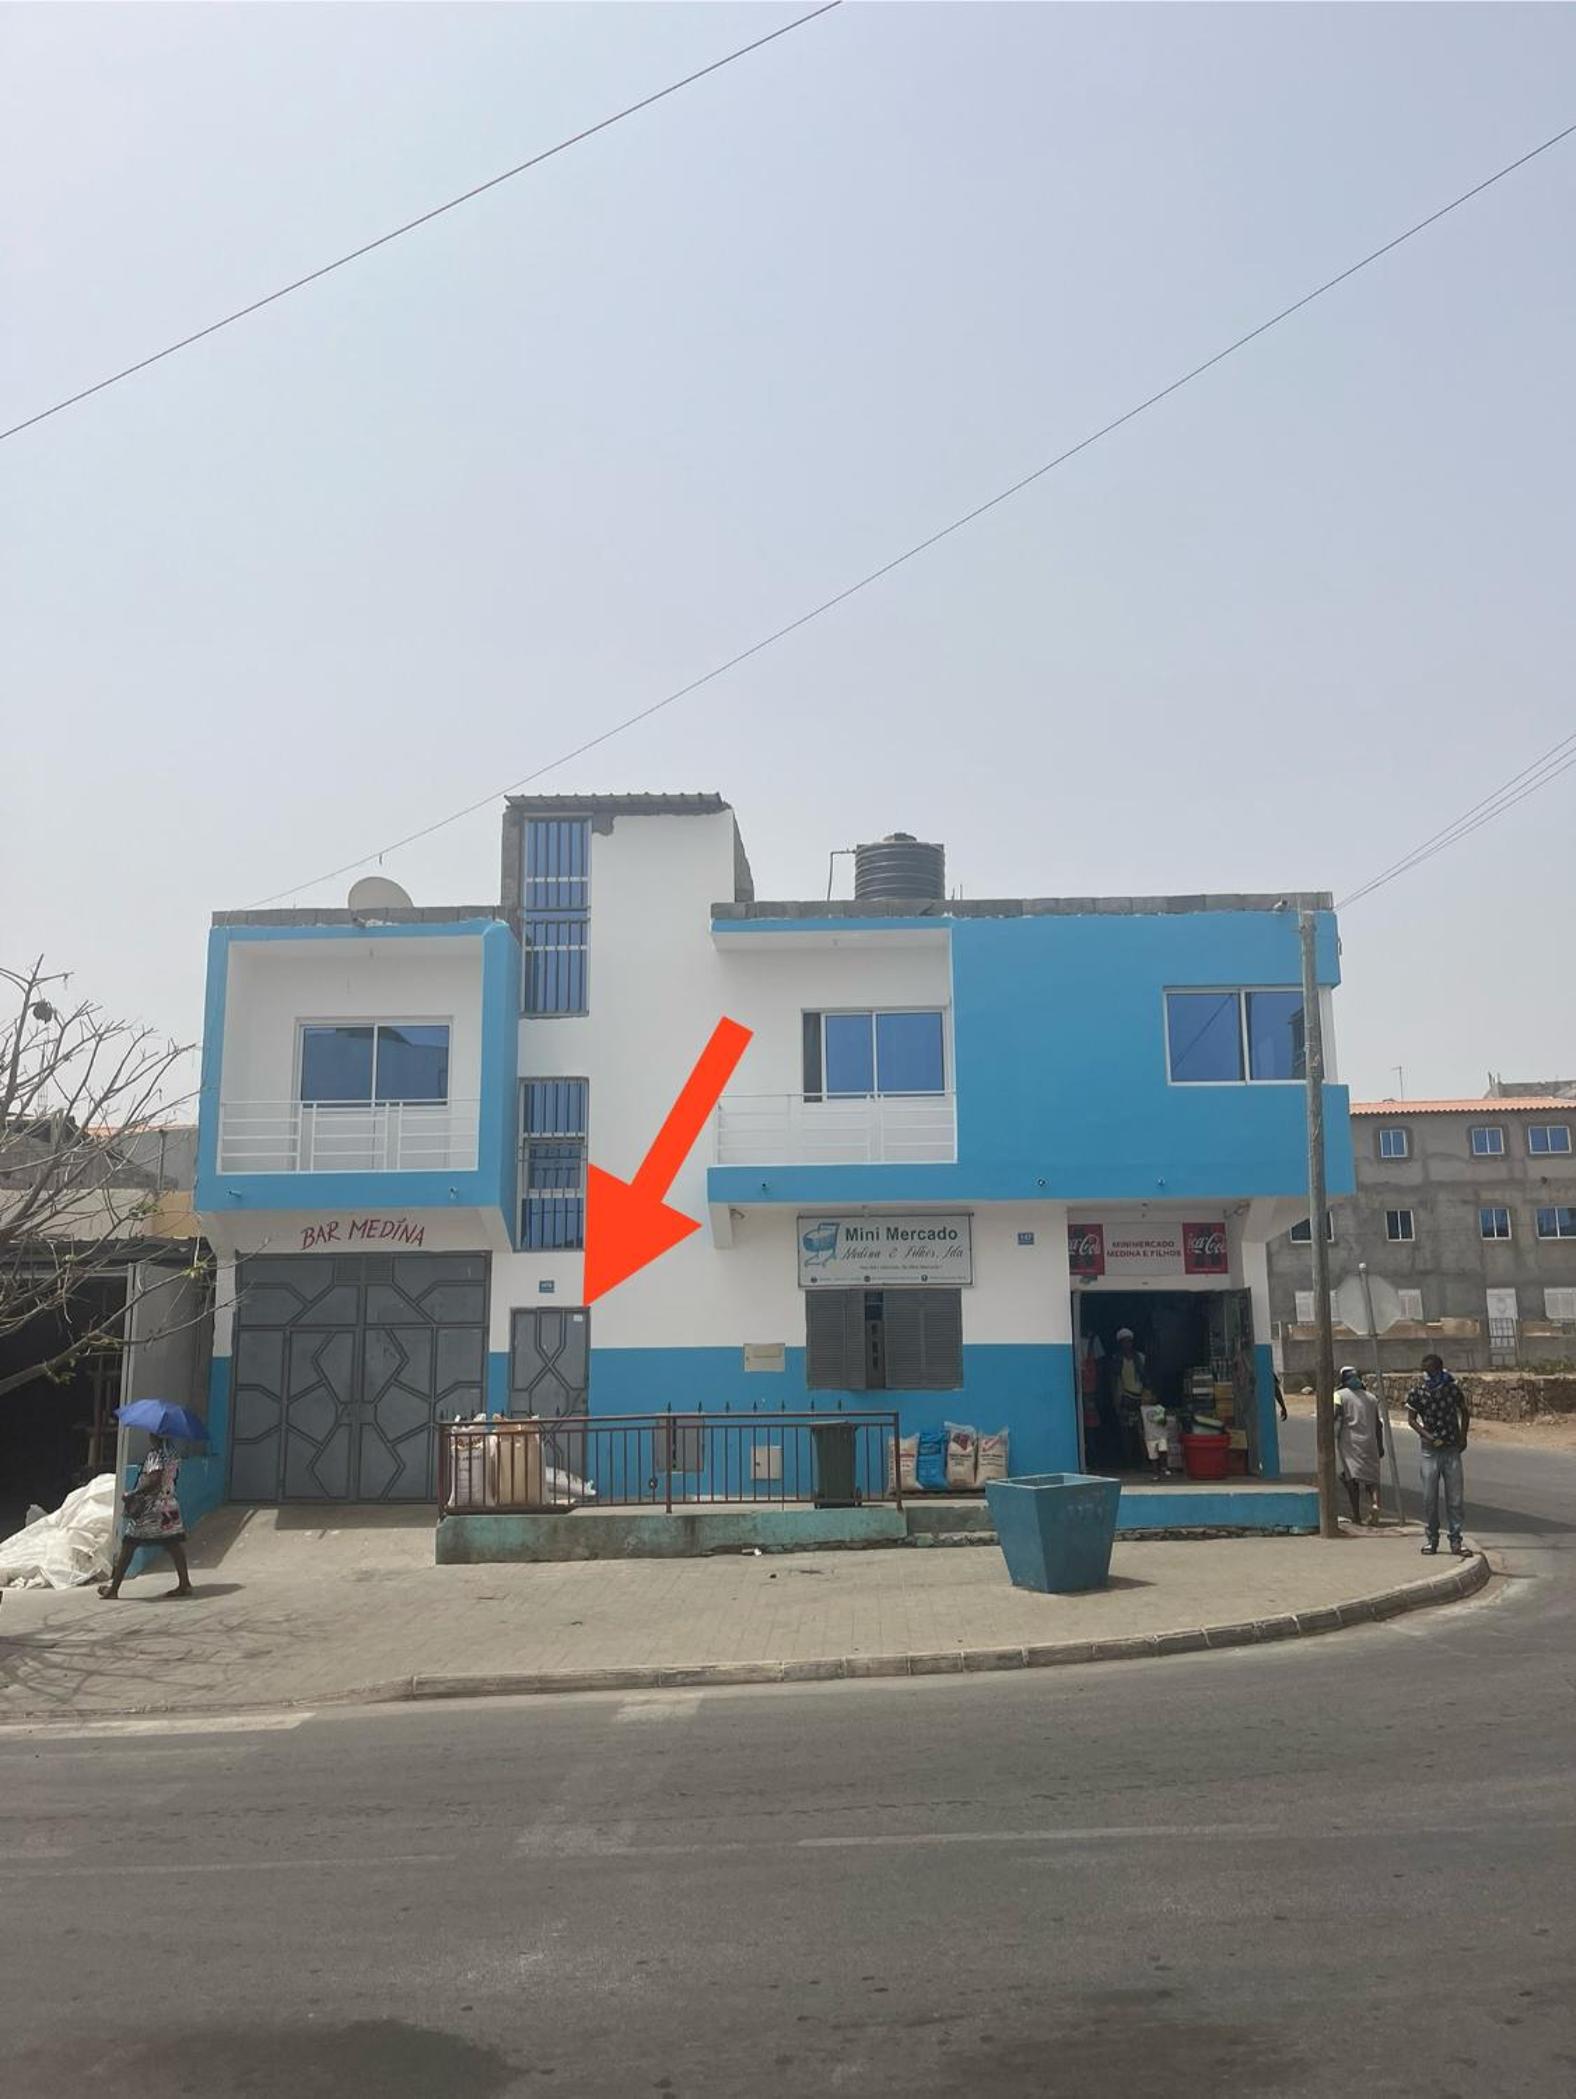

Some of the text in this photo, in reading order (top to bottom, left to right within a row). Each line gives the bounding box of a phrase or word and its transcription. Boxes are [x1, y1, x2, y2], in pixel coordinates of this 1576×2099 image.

[300, 1221, 341, 1250] BAR
[845, 1226, 958, 1241] Mini Mercado
[1112, 1240, 1175, 1248] MINIMERCADO
[1107, 1249, 1141, 1257] MEDINA
